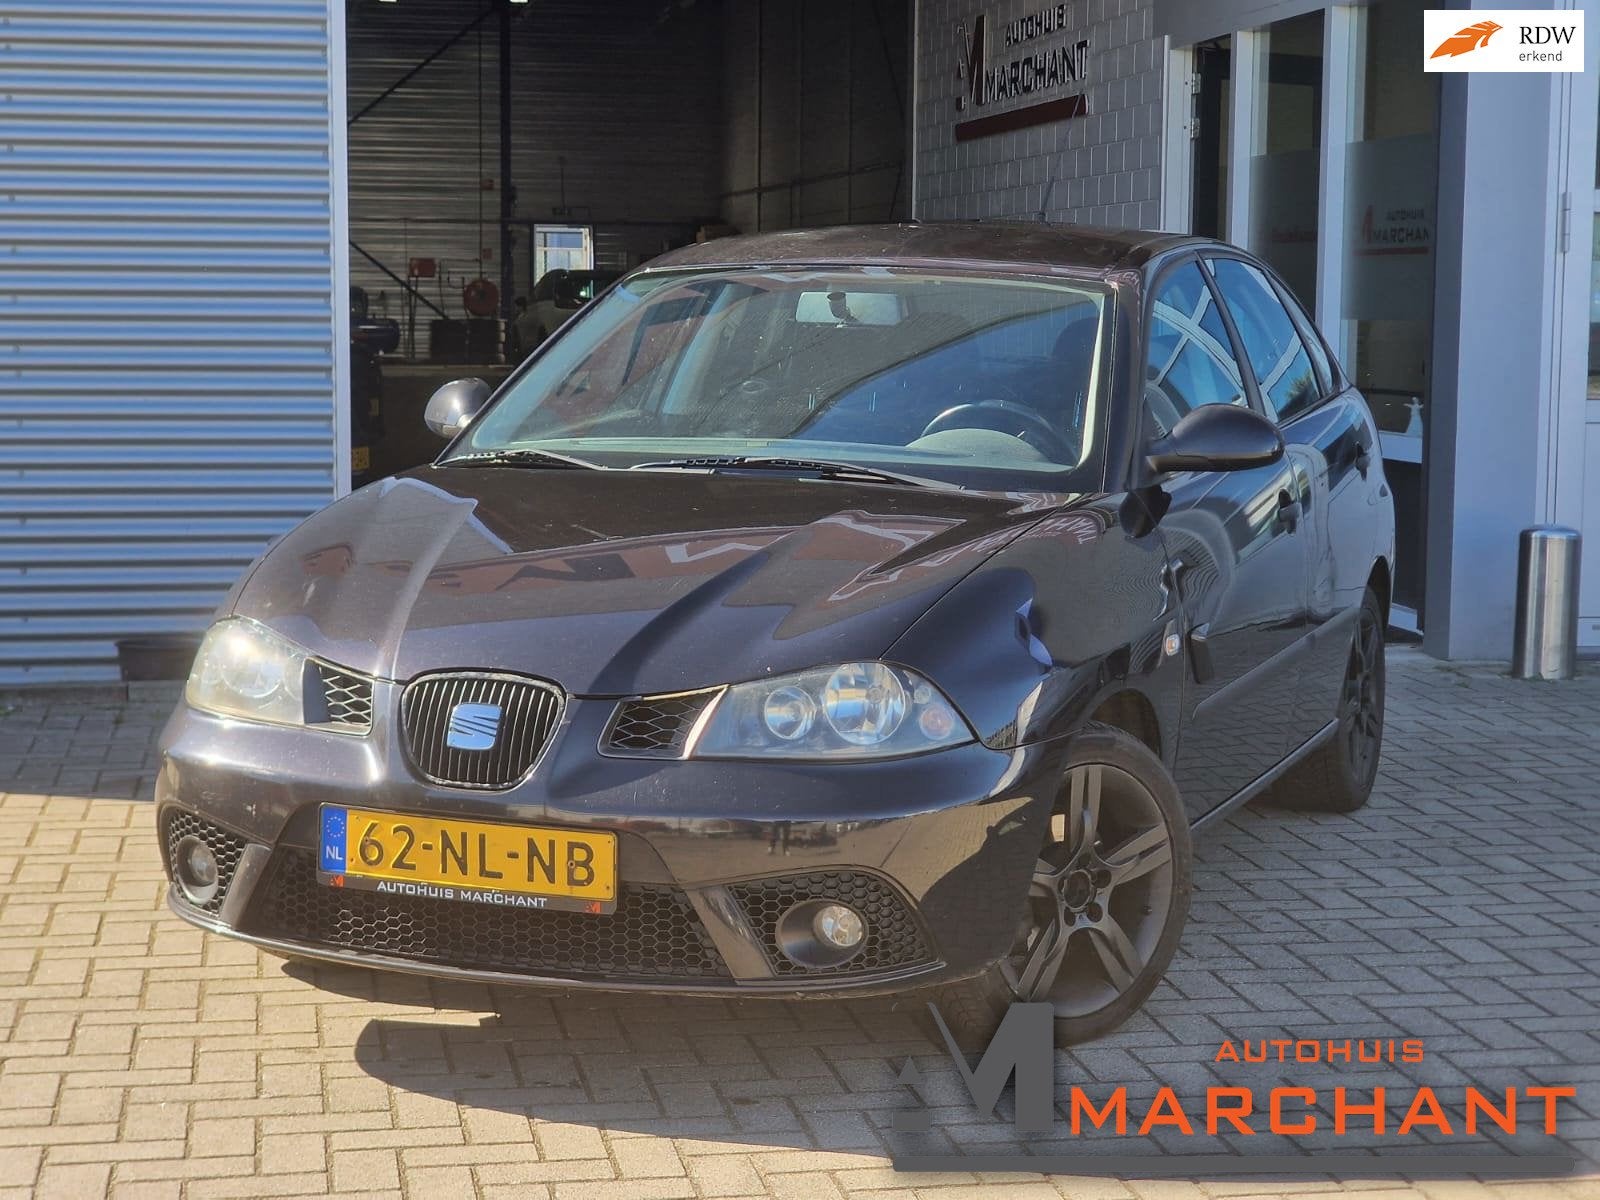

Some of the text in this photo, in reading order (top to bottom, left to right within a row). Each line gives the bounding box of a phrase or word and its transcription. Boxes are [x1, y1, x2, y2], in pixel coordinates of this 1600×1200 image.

[1006, 4, 1067, 47] AUTOHUIS
[984, 39, 1090, 105] MARCHANT
[325, 845, 343, 861] NL
[358, 820, 595, 887] 62-NL-NB
[376, 880, 548, 908] AUTOHUIS MARCHANT
